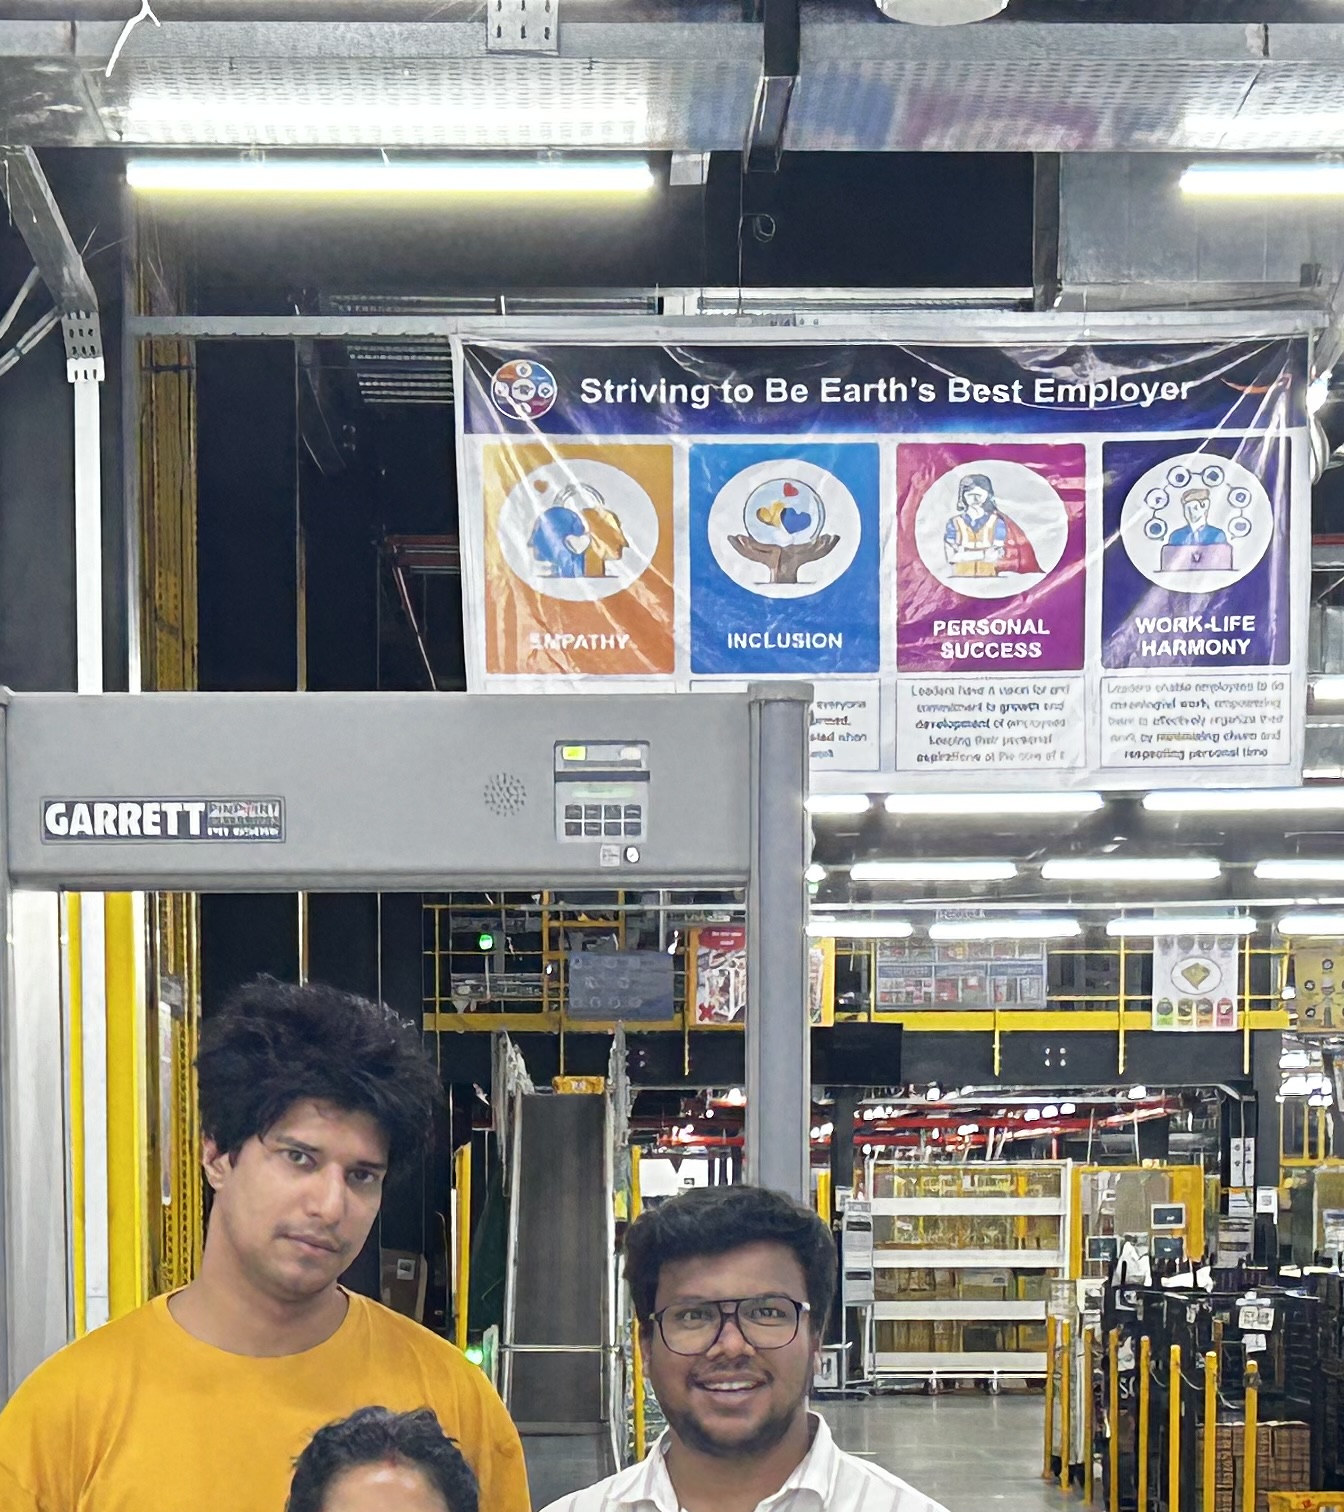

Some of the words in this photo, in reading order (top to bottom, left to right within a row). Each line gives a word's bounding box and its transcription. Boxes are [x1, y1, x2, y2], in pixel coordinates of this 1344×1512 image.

[580, 377, 710, 409] Striving
[721, 379, 754, 403] to
[766, 377, 808, 403] Be
[821, 377, 936, 403] Earth's
[948, 377, 1024, 403] Best
[1034, 376, 1192, 409] Employer
[933, 618, 1050, 637] PERSONAL
[1135, 615, 1256, 634] WORK-LIFE
[528, 632, 630, 650] EMPATHY
[727, 632, 843, 649] INCLUSION
[1141, 638, 1251, 656] HARMONY
[940, 641, 1042, 659] SUCCESS
[45, 802, 205, 836] GARRETT
